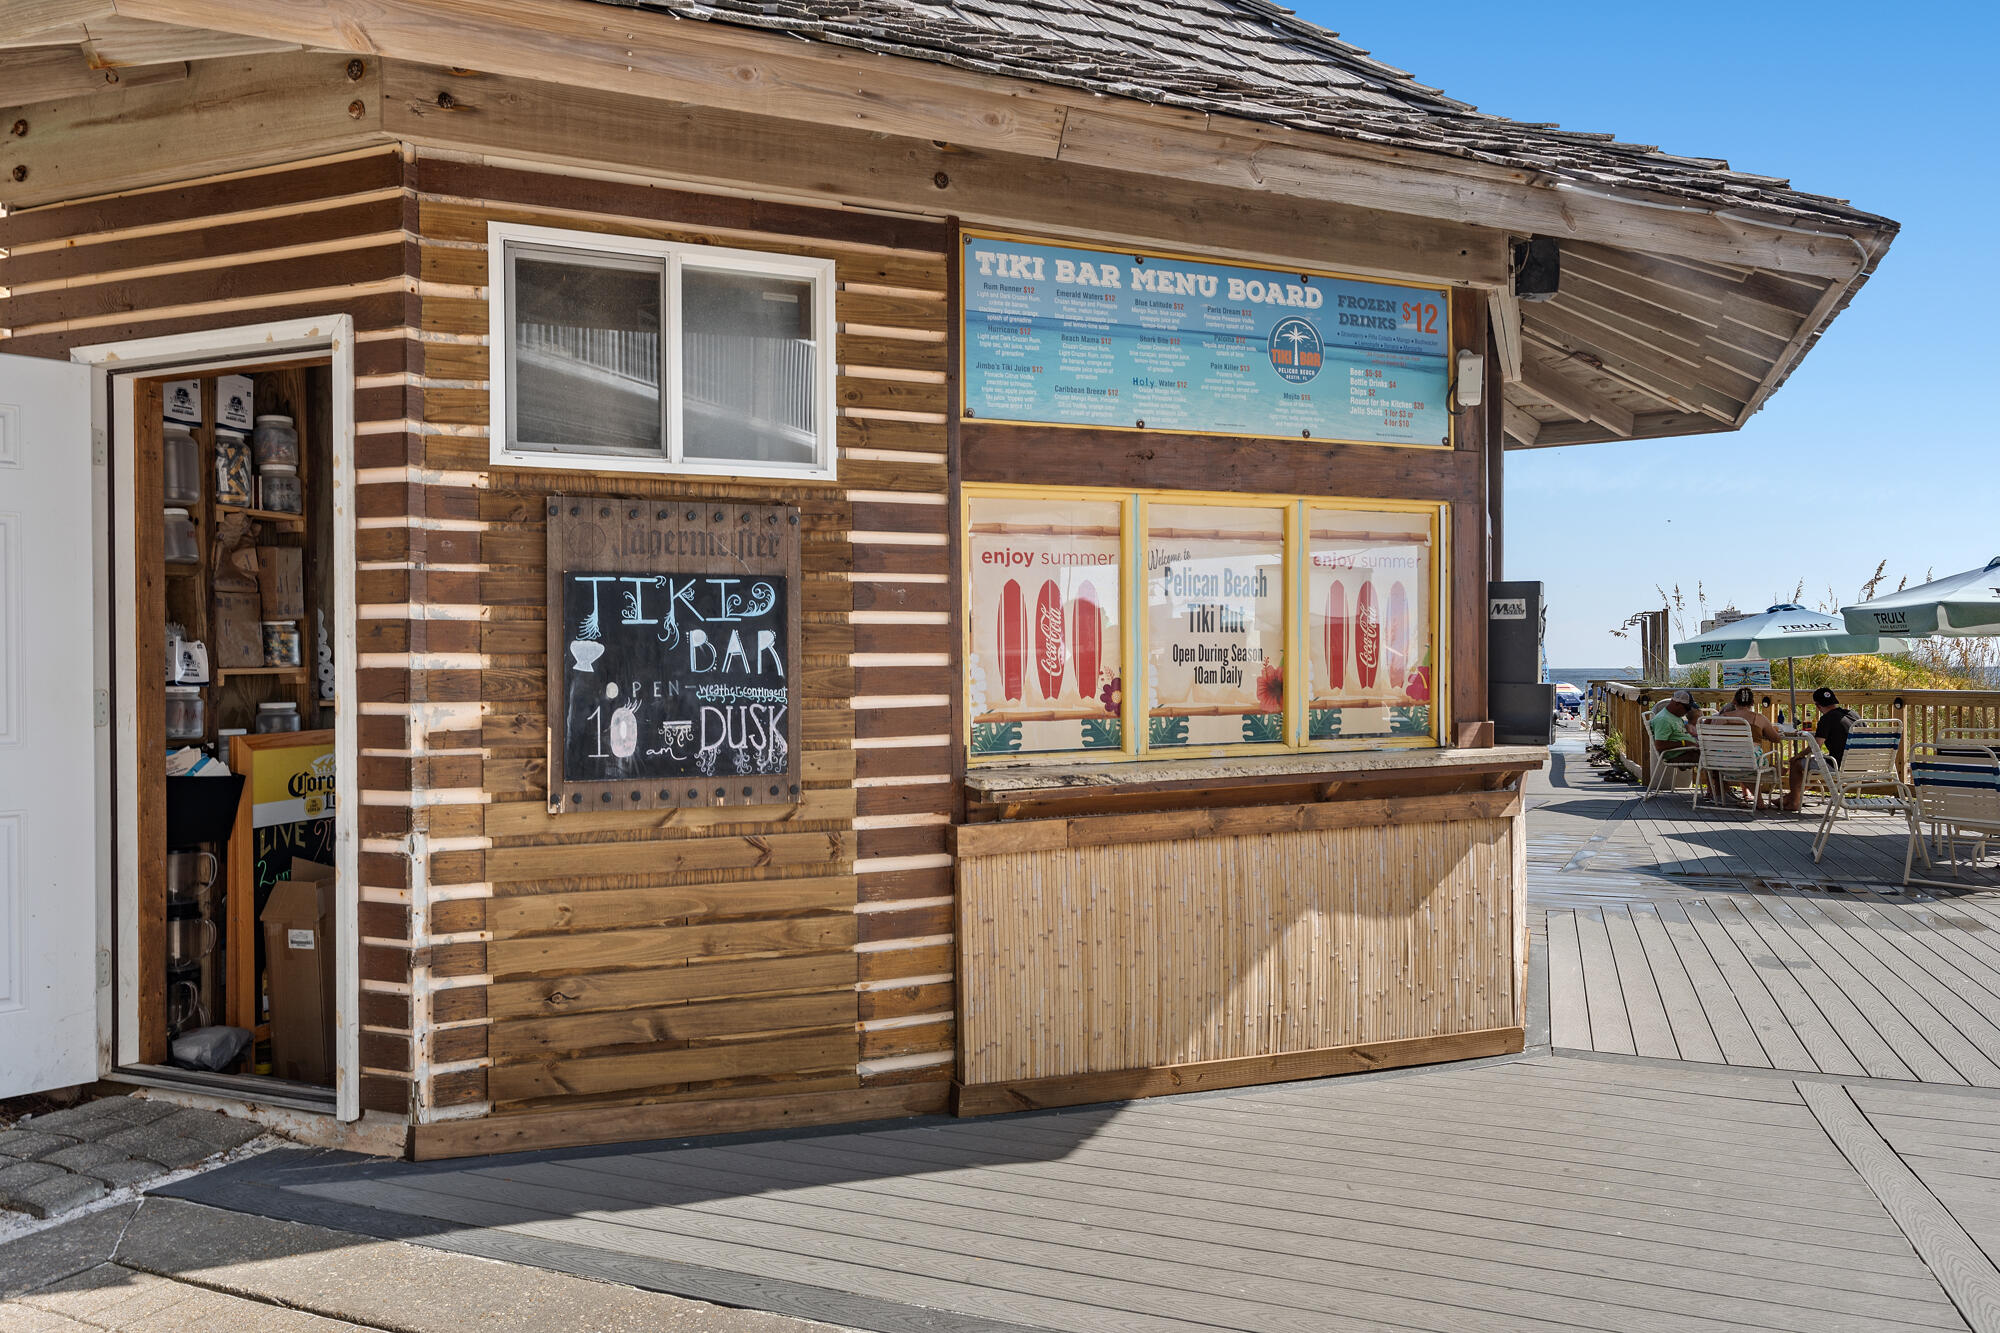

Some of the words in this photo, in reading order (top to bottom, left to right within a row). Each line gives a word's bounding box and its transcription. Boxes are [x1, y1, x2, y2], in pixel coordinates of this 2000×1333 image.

[975, 250, 1046, 281] TIKI
[1055, 259, 1122, 289] BAR
[1130, 267, 1219, 298] MENU
[1227, 278, 1324, 309] BOARD
[983, 282, 998, 291] Rum
[999, 283, 1022, 293] Runner
[1023, 285, 1035, 295] $12
[1056, 289, 1082, 299] Emerald
[1082, 292, 1104, 301] Waters
[1134, 299, 1148, 308] Blue
[1149, 300, 1172, 310] Latitude
[1207, 306, 1222, 314] Paris
[1222, 307, 1241, 316] Dream
[1337, 294, 1397, 313] FROZEN
[1402, 301, 1438, 335] $12
[1338, 312, 1398, 331] DRINKS
[987, 325, 1018, 334] Hurricane
[1019, 327, 1032, 336] $12
[1061, 334, 1080, 343] Beach
[1080, 335, 1100, 344] Mama
[1271, 348, 1293, 365] TIKI
[1299, 350, 1321, 367] BAR
[975, 361, 1001, 370] Jimbo's
[1001, 363, 1013, 371] Tiki
[1014, 364, 1031, 373] Juice
[1223, 363, 1239, 371] Killer
[1278, 367, 1299, 375] PELICAN
[1299, 368, 1315, 376] BEACH
[1349, 367, 1364, 376] Beer
[1132, 376, 1156, 390] Holy
[1158, 379, 1176, 388] Water
[1349, 377, 1368, 387] Bottle
[1368, 379, 1388, 389] Drinks
[1388, 380, 1397, 389] $4
[1054, 384, 1085, 394] Caribbean
[1086, 386, 1107, 396] Breeze
[1283, 392, 1300, 401] Mojito
[1349, 387, 1367, 397] Chips
[1368, 388, 1376, 397] $2
[1349, 396, 1370, 406] Round
[1370, 398, 1379, 407] for
[1380, 399, 1390, 408] the
[1390, 400, 1413, 409] Kitchen
[1413, 401, 1425, 410] $20
[1366, 407, 1383, 416] Shots
[1389, 409, 1398, 417] for
[1398, 409, 1407, 418] $3
[1383, 418, 1388, 426] 4
[1389, 419, 1398, 427] for
[1398, 419, 1410, 428] $10
[981, 548, 1035, 568] enjoy
[1040, 552, 1115, 566] summer
[1147, 548, 1182, 570] Welcome
[1183, 548, 1192, 560] to
[1313, 552, 1356, 570] enjoy
[1361, 554, 1422, 569] summer
[1164, 566, 1219, 597] Pelican
[1223, 567, 1268, 598] Beach
[574, 576, 776, 634] TIKI
[1187, 603, 1215, 633] Tiki
[1219, 604, 1245, 633] Hut
[1873, 611, 1906, 624] TRULY
[1777, 622, 1833, 630] TRULY
[1040, 602, 1064, 677] Coca-Cola
[686, 629, 784, 676] BAR
[1700, 643, 1727, 653] TRULY
[1172, 643, 1196, 667] Open
[1198, 643, 1230, 667] During
[1231, 643, 1263, 662] Season
[1193, 665, 1218, 685] 10am
[1220, 665, 1243, 688] Daily
[587, 701, 638, 758] 10
[646, 747, 682, 761] am
[696, 704, 788, 764] DUSK
[260, 820, 309, 859] LIVE
